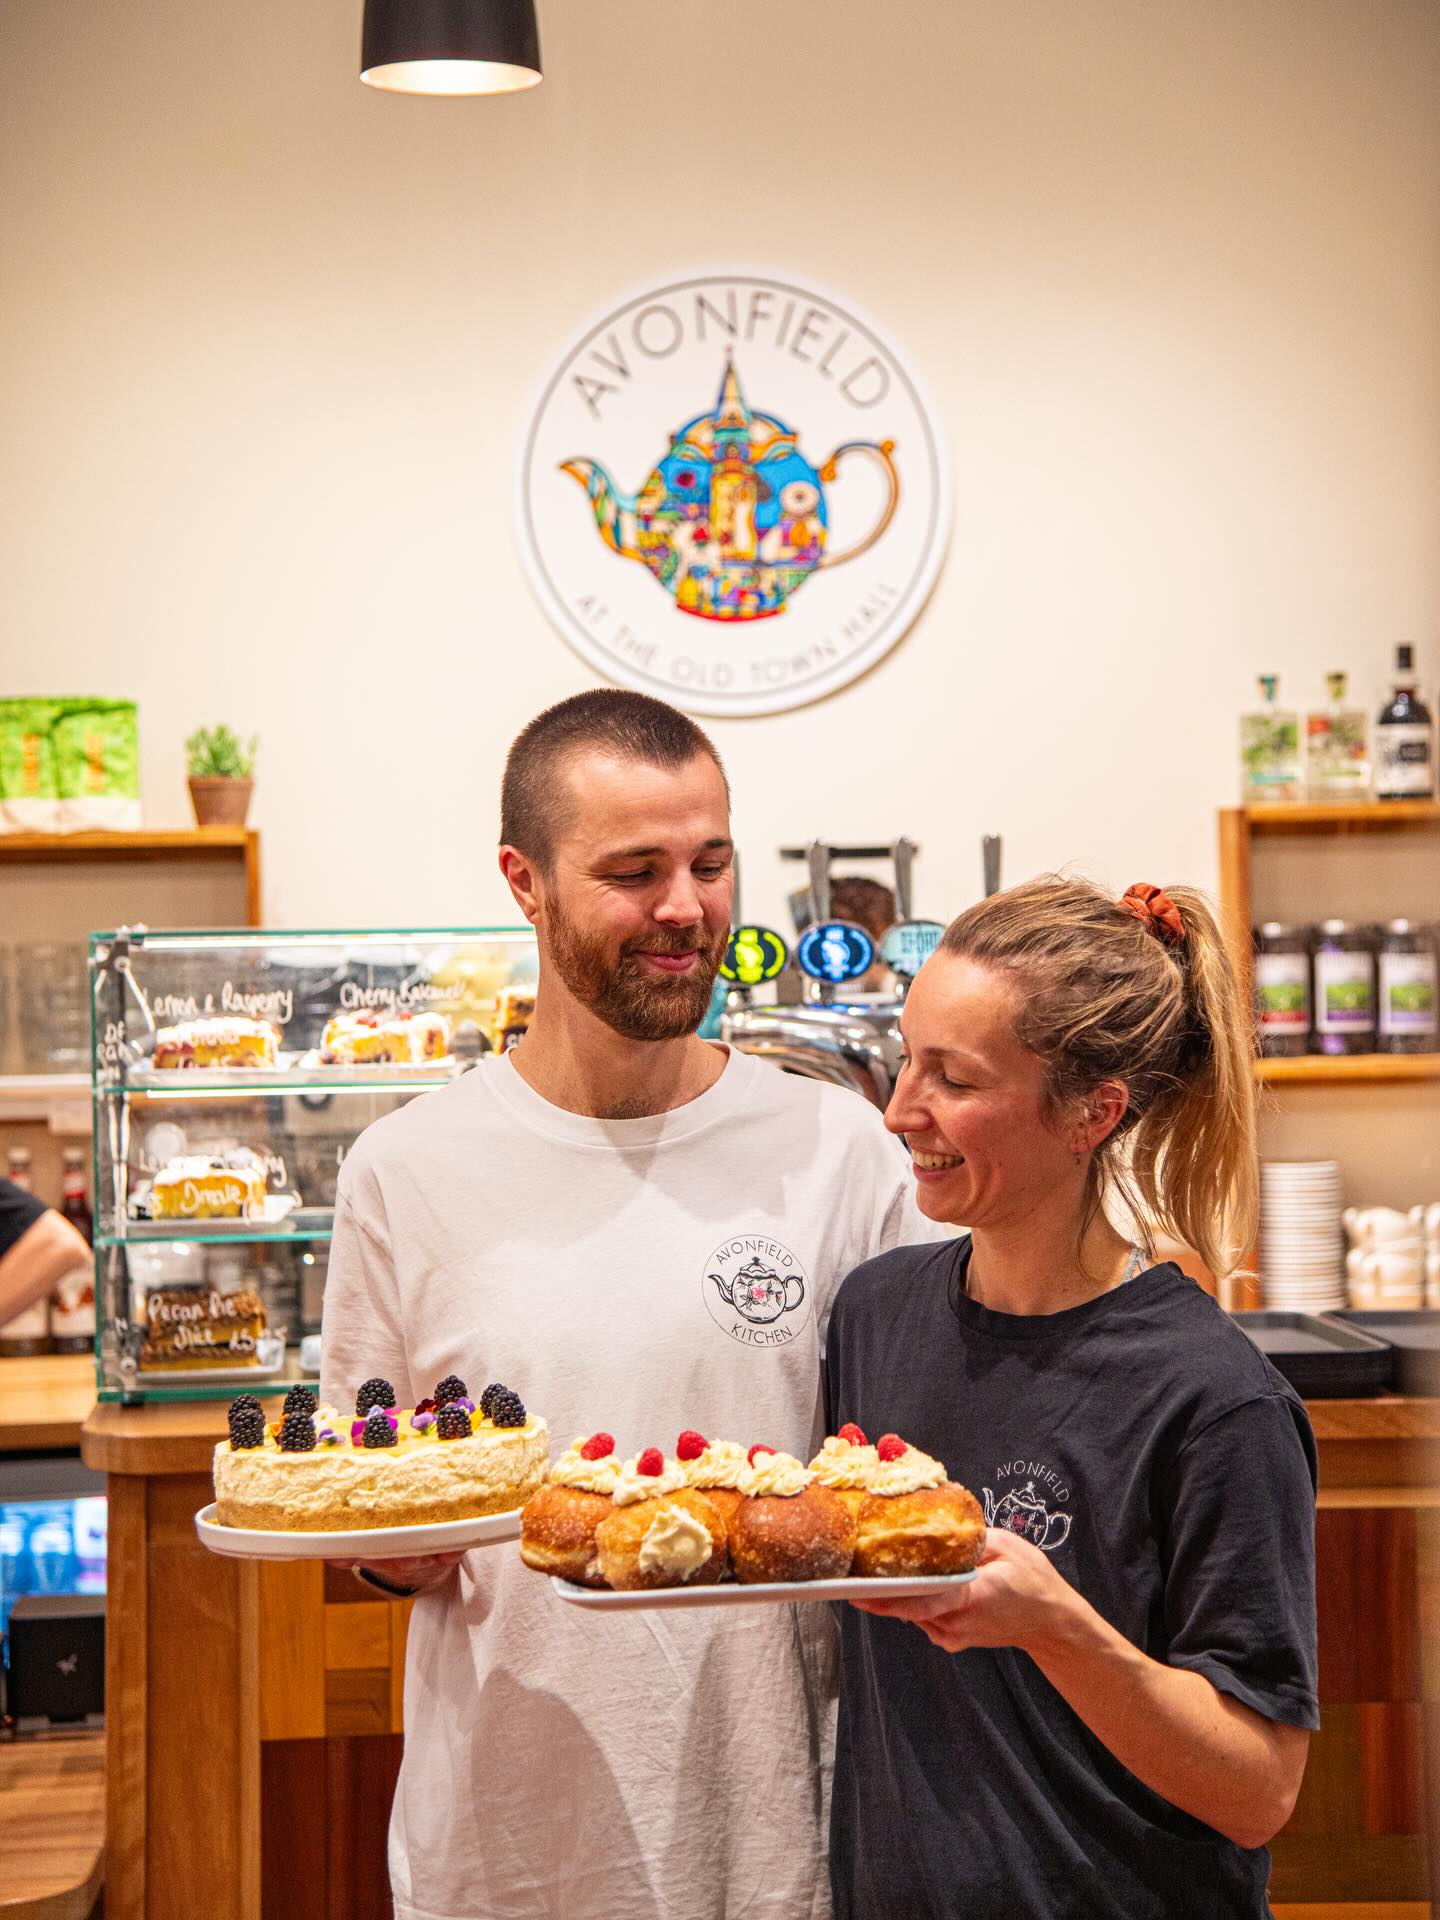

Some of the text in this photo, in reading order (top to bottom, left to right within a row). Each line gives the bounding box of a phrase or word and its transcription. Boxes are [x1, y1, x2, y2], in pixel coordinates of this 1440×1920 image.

[571, 288, 892, 420] AVONFIELD
[576, 582, 898, 688] AT THE OLD TOWN HALL
[715, 1239, 794, 1268] AVONFIELD
[731, 1322, 794, 1345] KITCHEN
[995, 1459, 1071, 1503] AVONFIELD
